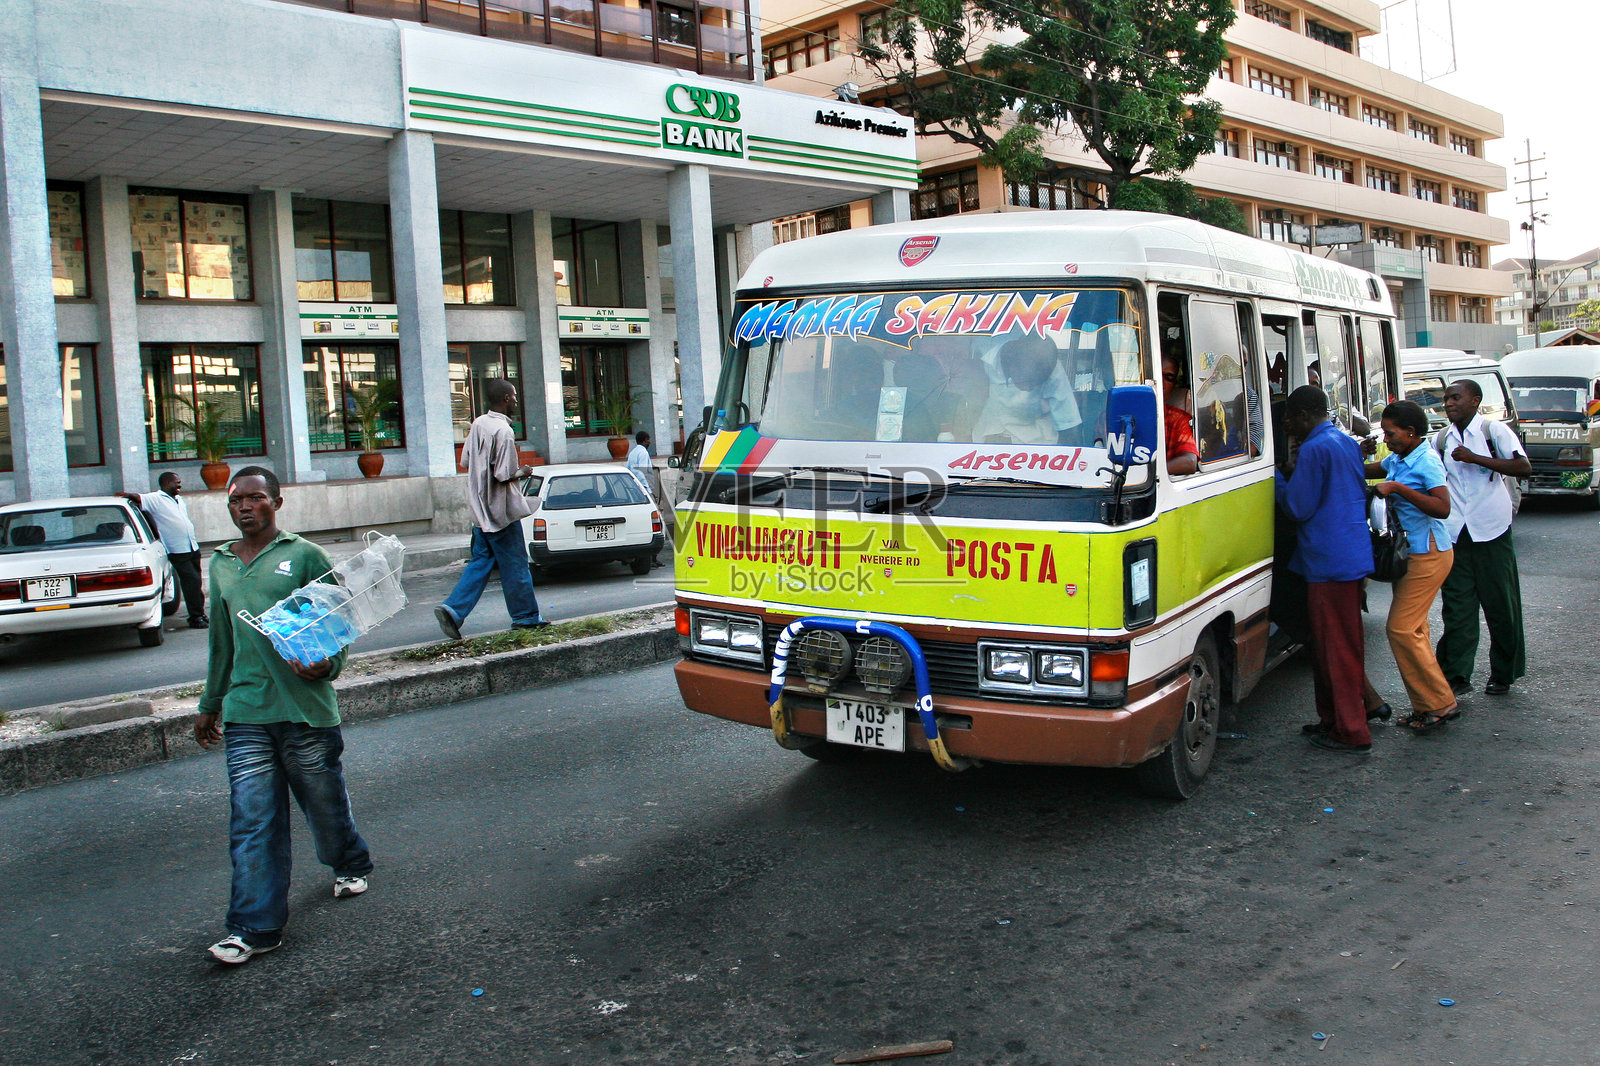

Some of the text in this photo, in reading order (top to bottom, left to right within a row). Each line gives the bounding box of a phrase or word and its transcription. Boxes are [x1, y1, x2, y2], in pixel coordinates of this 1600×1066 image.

[665, 83, 741, 123] CRDB
[665, 122, 743, 153] BANK
[349, 305, 372, 313] ATM
[734, 292, 1080, 349] MAMAA SAKINA
[1543, 428, 1580, 440] POSTA
[947, 447, 1082, 471] Arsenal
[695, 521, 841, 570] VINGUNGUTI
[882, 539, 900, 548] VIA
[906, 557, 920, 566] RD
[946, 538, 1058, 584] POSTA
[37, 578, 61, 588] T 322
[44, 587, 61, 597] AGF
[843, 702, 886, 724] T 403
[854, 725, 885, 747] APE
